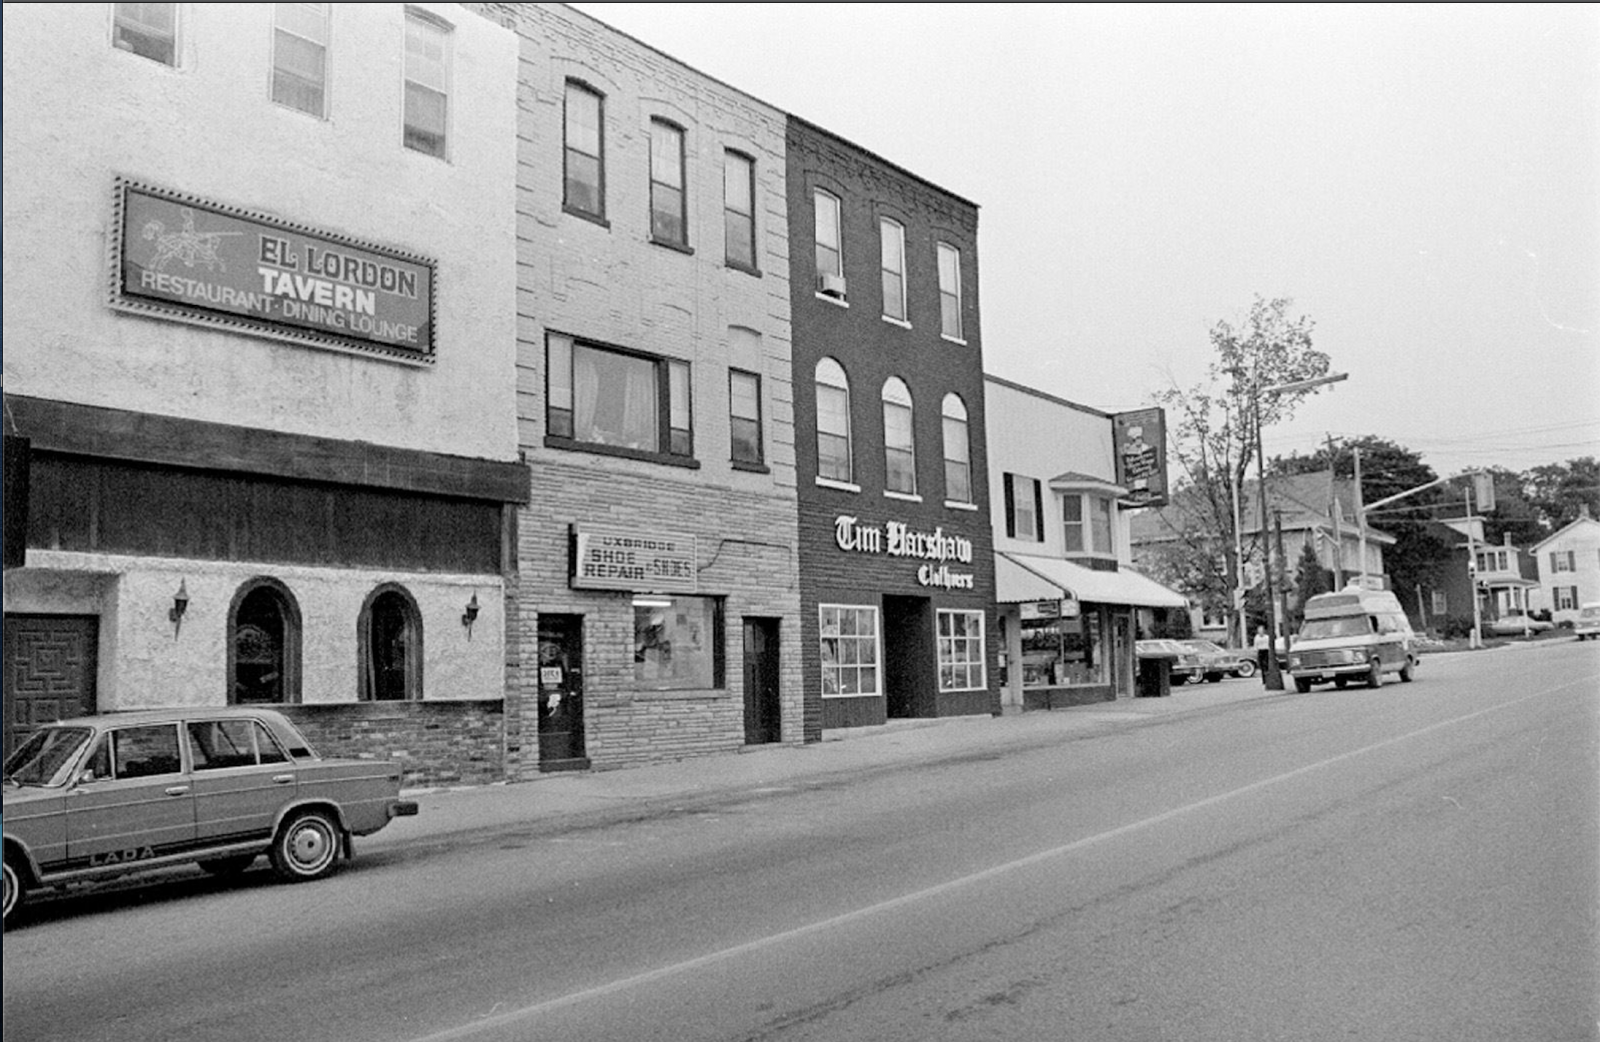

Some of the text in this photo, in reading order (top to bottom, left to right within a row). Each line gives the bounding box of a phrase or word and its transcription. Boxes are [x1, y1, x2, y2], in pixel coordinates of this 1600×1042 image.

[258, 233, 418, 298] EL LORDON
[141, 269, 418, 343] RESTAURANT DINING LOUNGE
[258, 266, 376, 316] TAVERN
[591, 549, 636, 565] SHOE
[602, 536, 676, 552] UXBRIDGE
[835, 515, 972, 564] Tim Harshaw
[584, 563, 644, 580] REPAIR
[90, 846, 155, 867] LADA
